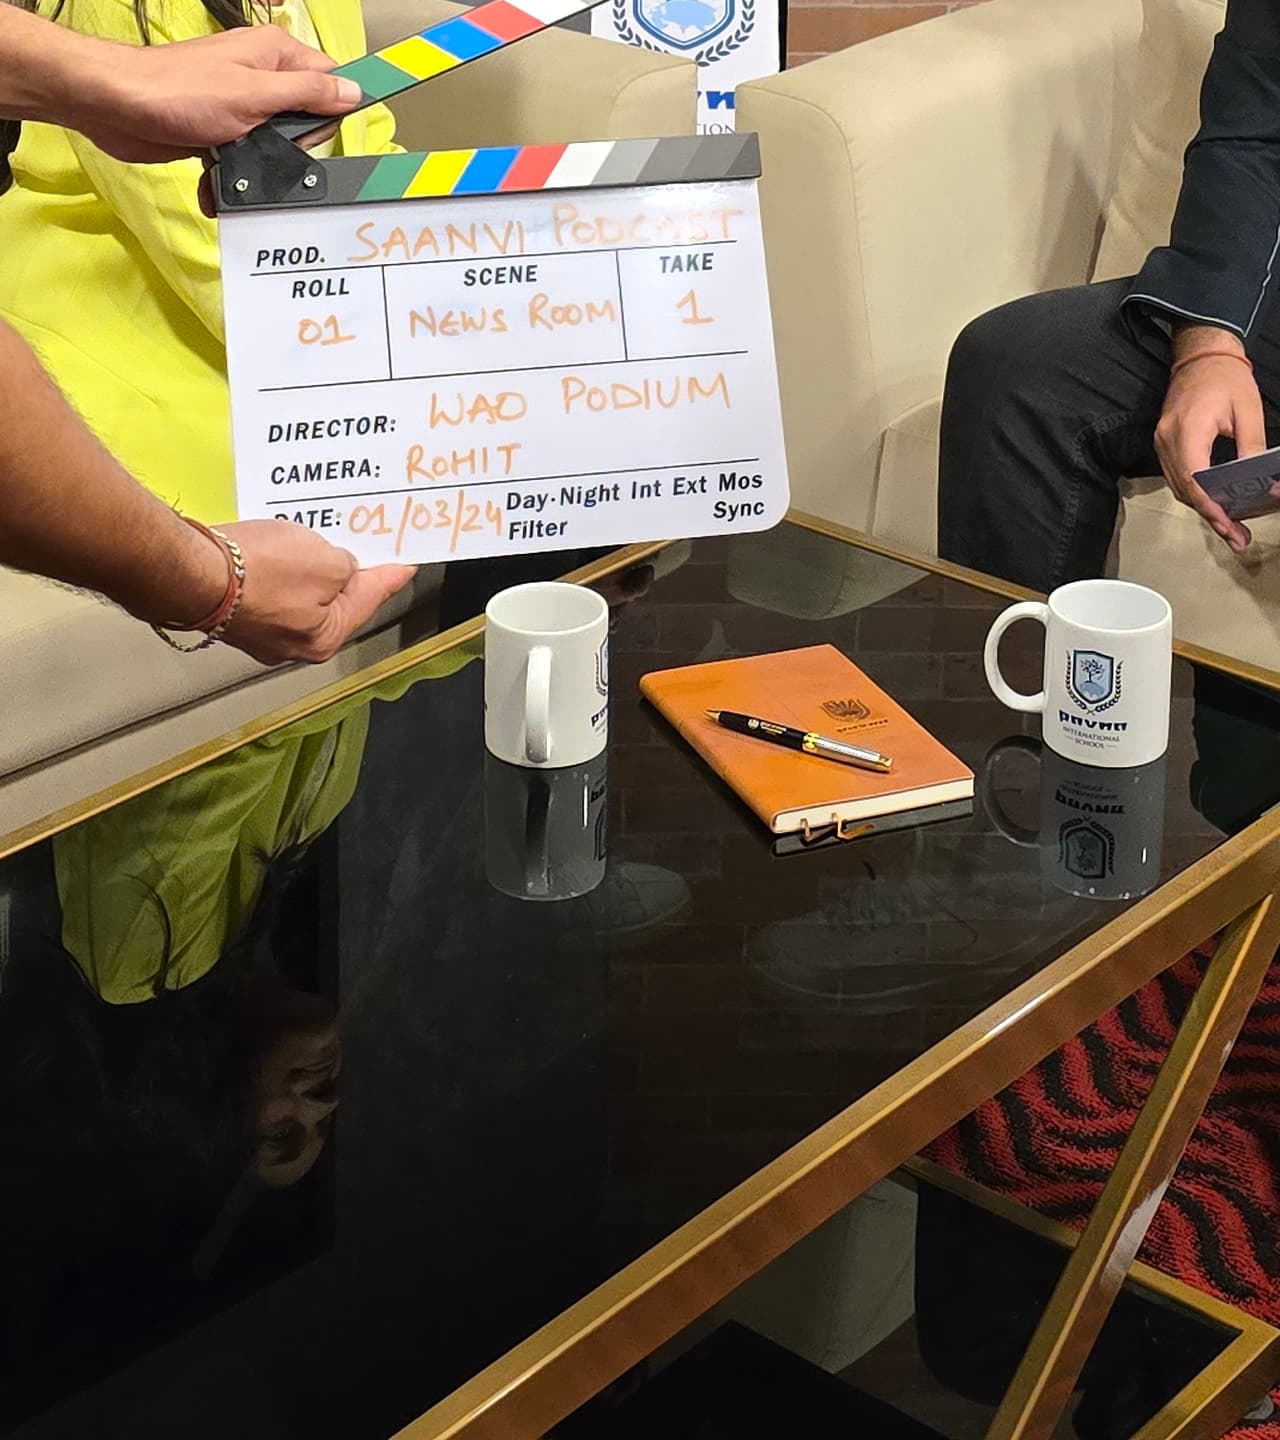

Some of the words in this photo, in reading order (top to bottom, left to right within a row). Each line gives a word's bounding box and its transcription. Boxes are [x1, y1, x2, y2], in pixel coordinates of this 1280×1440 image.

[347, 221, 526, 262] SAANVI
[256, 246, 326, 268] PROD.
[660, 252, 714, 274] TAKE
[291, 277, 350, 299] ROLL
[463, 264, 538, 286] SCENE
[409, 306, 508, 338] NEWS
[528, 292, 617, 331] ROOM
[676, 289, 715, 325] 1
[298, 314, 357, 346] 01
[429, 391, 528, 429] WAO
[561, 372, 731, 415] PODIUM
[268, 415, 397, 443] DIRECTOR:
[271, 458, 381, 485] CAMERA:
[406, 443, 522, 484] ROHIT
[631, 479, 662, 500] Int
[673, 475, 708, 496] Ext
[719, 472, 763, 492] Mos
[713, 501, 765, 522] Sync
[508, 520, 568, 541] Filter
